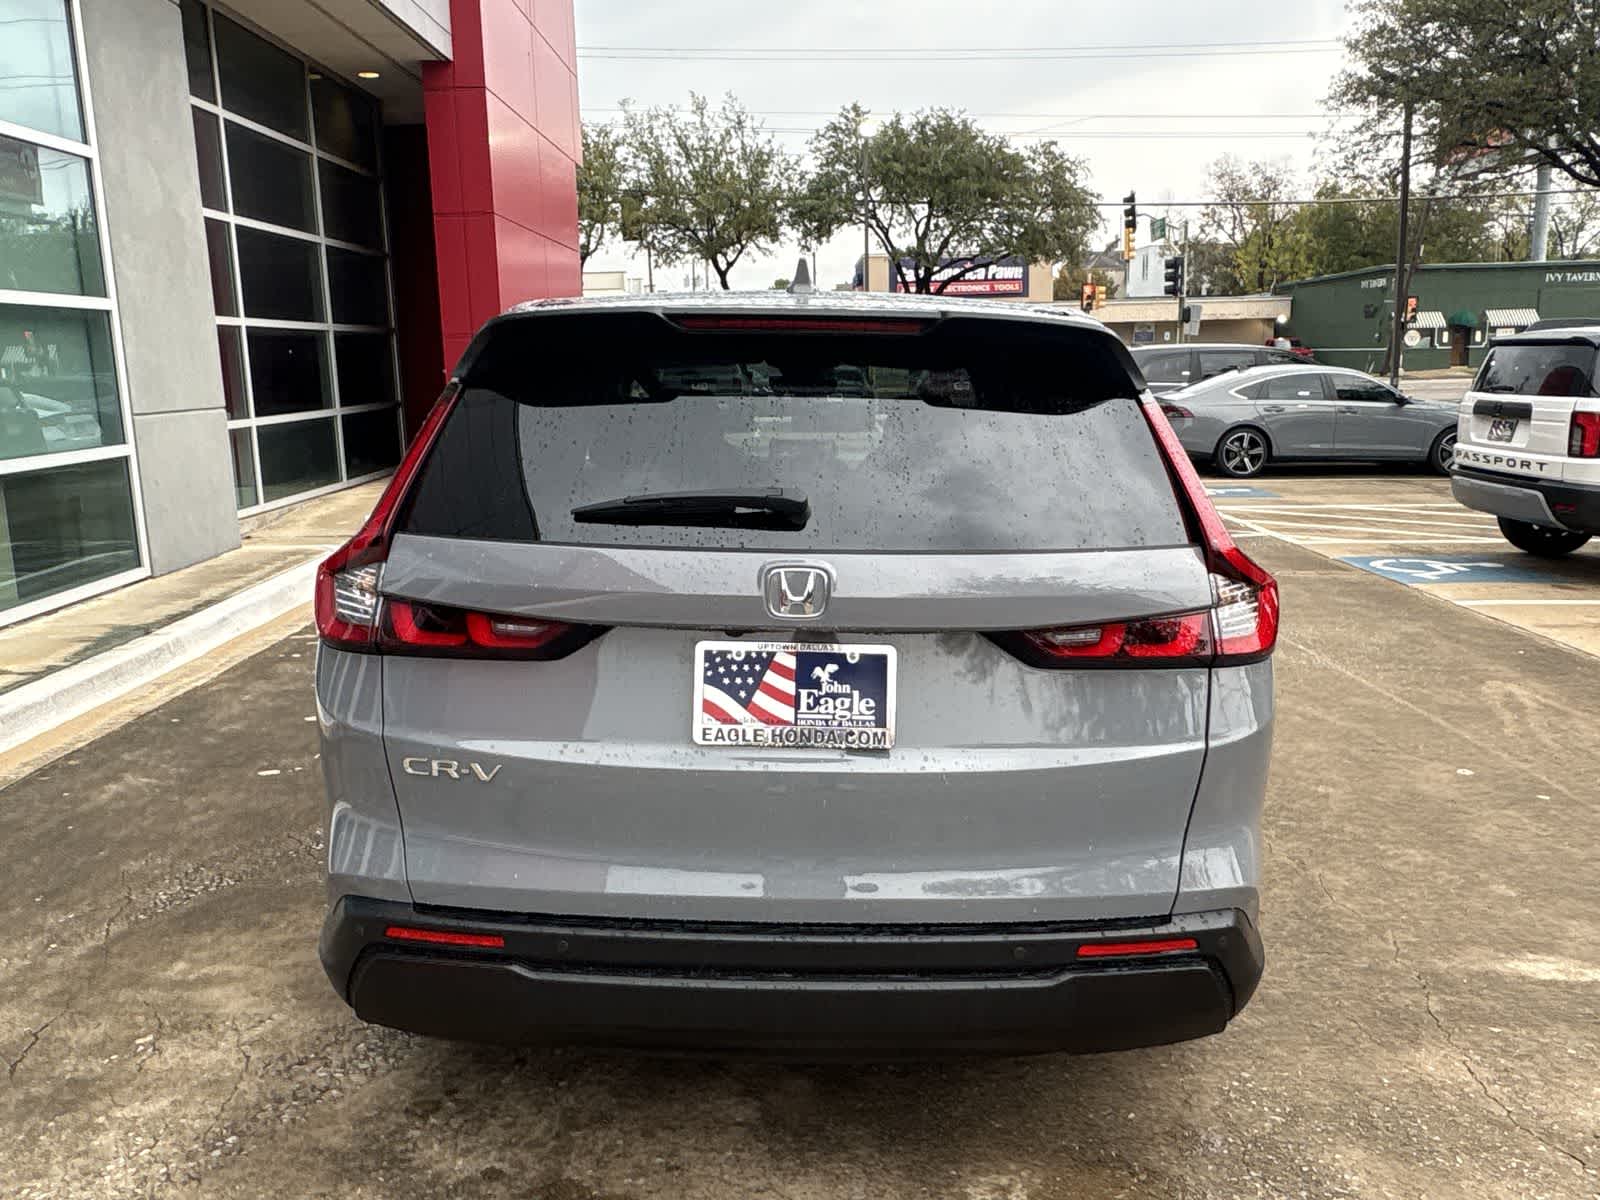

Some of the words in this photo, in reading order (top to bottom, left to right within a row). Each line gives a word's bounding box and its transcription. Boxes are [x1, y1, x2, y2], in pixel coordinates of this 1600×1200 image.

[988, 265, 1023, 280] Pawn
[1545, 272, 1564, 283] IVY
[941, 284, 990, 293] LECTRONICS
[994, 283, 1020, 292] TOOLS
[1455, 449, 1549, 473] PASSPORT
[757, 643, 797, 651] UPTOWN
[797, 688, 876, 721] Eagle
[797, 719, 826, 727] HONDA
[402, 757, 503, 782] CR-V
